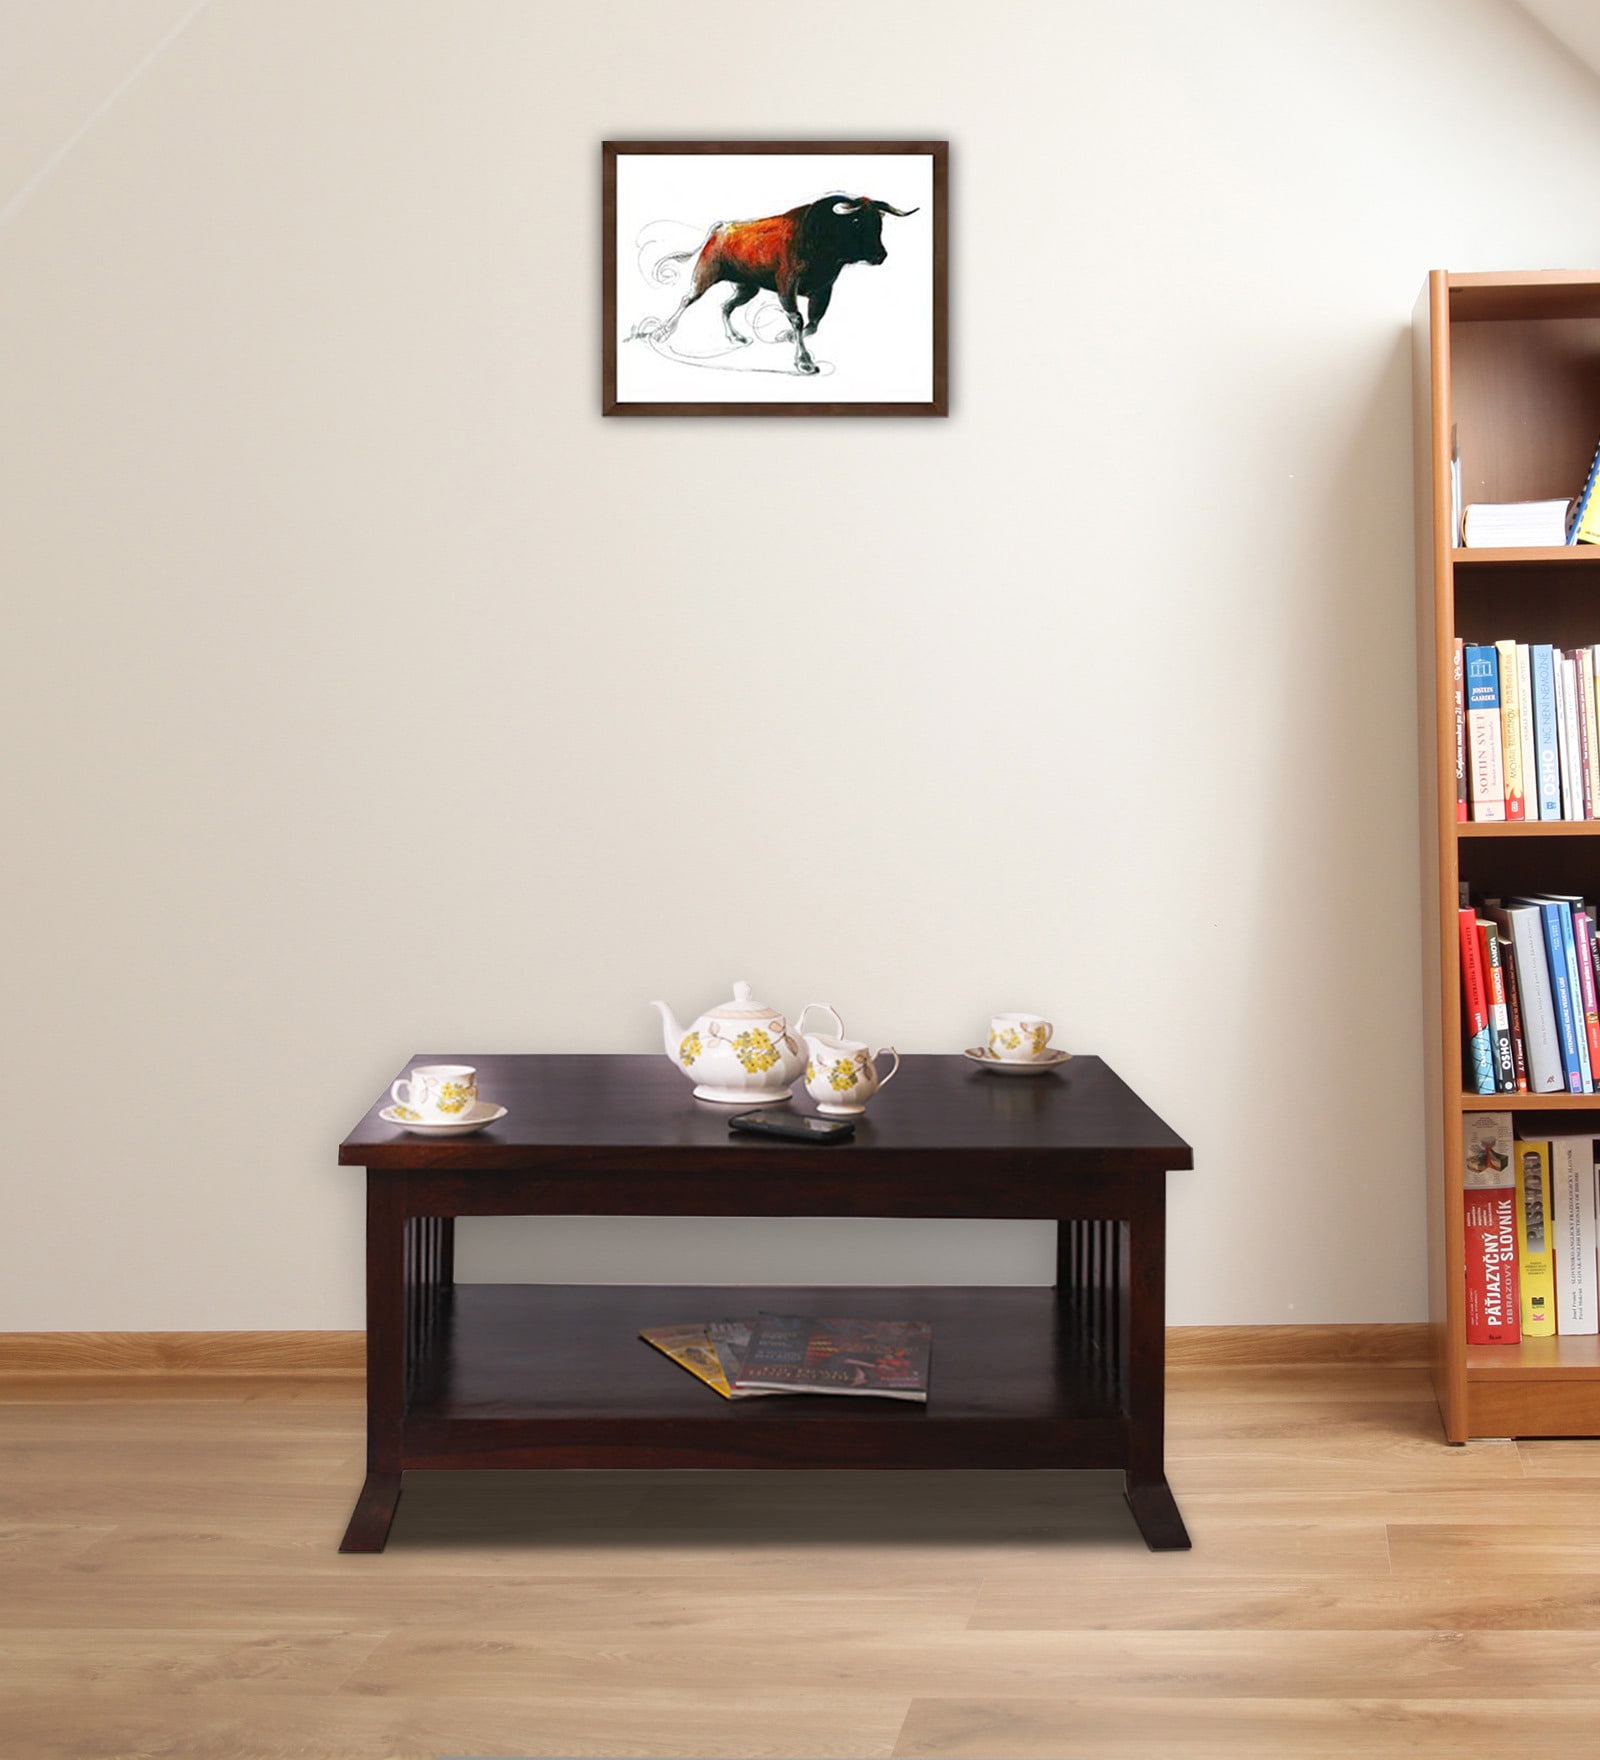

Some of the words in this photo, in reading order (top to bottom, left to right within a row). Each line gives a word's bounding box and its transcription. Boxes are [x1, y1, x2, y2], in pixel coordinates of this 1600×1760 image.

[1538, 652, 1549, 700] NEMOŽNÉ
[1541, 702, 1551, 725] NENÍ
[1476, 715, 1486, 746] SVET
[1543, 728, 1552, 744] NIC
[1477, 750, 1488, 794] SOFIIN
[1542, 749, 1556, 796] OSHO
[1489, 937, 1498, 967] SAMOTA
[1492, 968, 1503, 1003] SVOBODA
[1560, 988, 1569, 1008] VEDENÍ
[1496, 1004, 1506, 1027] LÁSKA
[1563, 1009, 1571, 1023] KURZ
[1499, 1037, 1511, 1070] OSHO
[1524, 1151, 1545, 1241] PASSWORD
[1496, 1199, 1514, 1261] SLOVNÍK
[1482, 1232, 1502, 1326] PÄŤJAZYČNÝ
